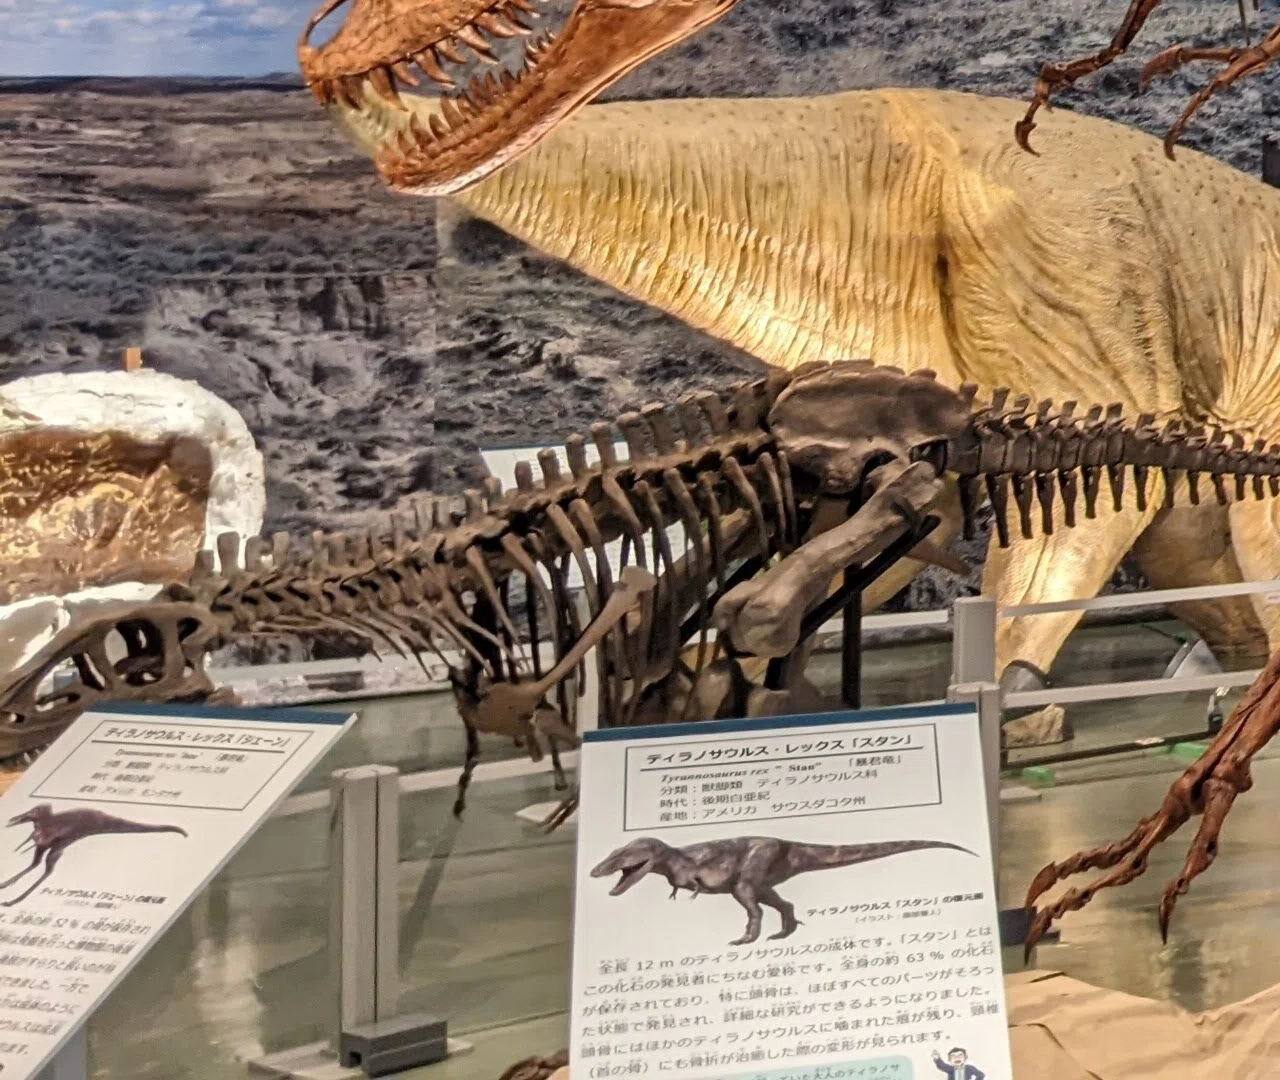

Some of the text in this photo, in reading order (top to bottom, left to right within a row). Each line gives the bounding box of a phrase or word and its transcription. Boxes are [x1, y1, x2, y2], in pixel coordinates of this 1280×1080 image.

[750, 767, 771, 777] rex
[906, 952, 925, 963] 63
[636, 960, 655, 971] 12
[659, 960, 674, 969] m
